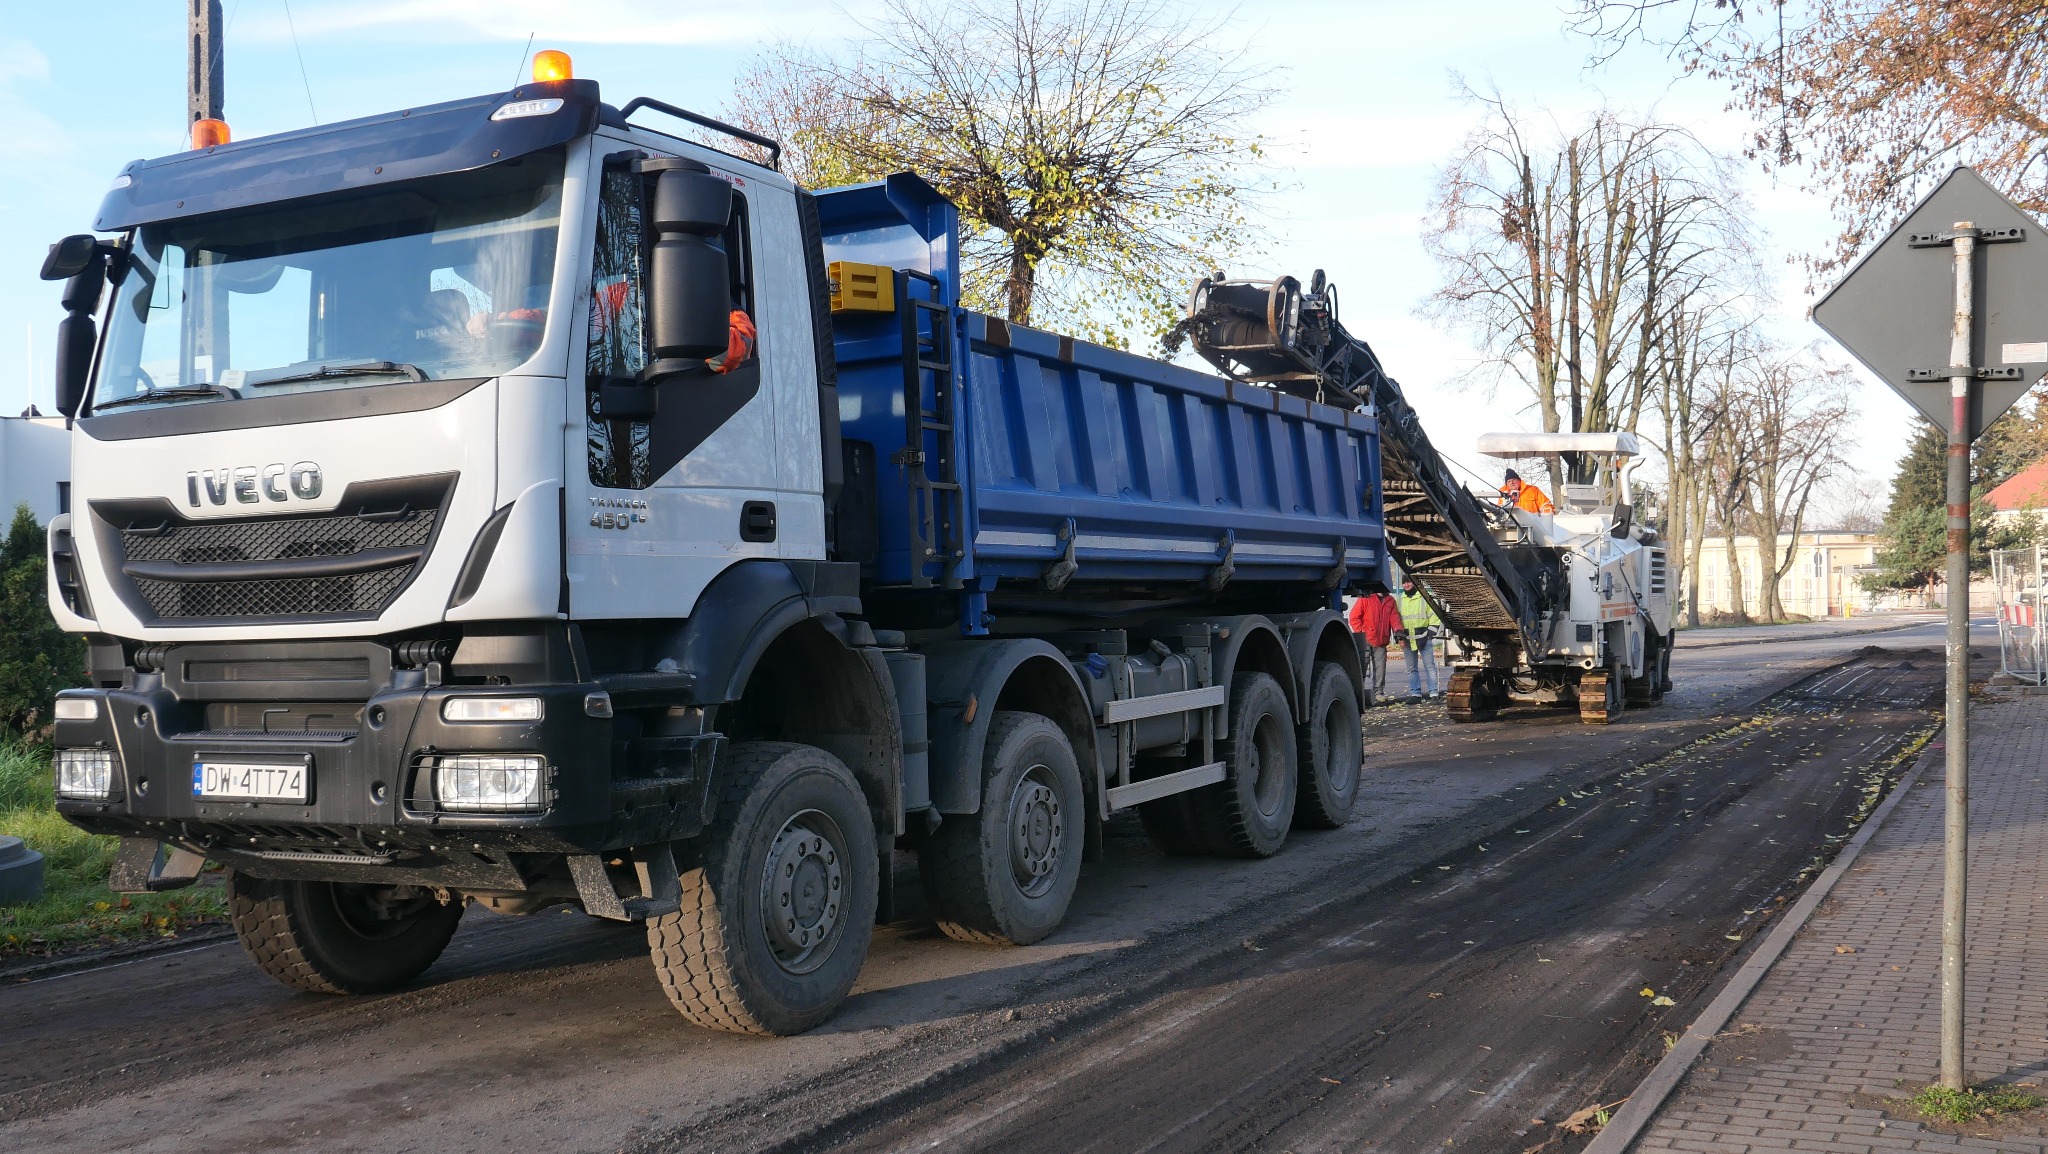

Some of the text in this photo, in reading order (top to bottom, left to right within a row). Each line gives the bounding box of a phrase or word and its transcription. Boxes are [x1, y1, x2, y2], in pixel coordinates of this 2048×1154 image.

[187, 461, 324, 507] IVECO
[589, 497, 648, 510] TRAKKER
[206, 767, 301, 796] DW 4TT74
